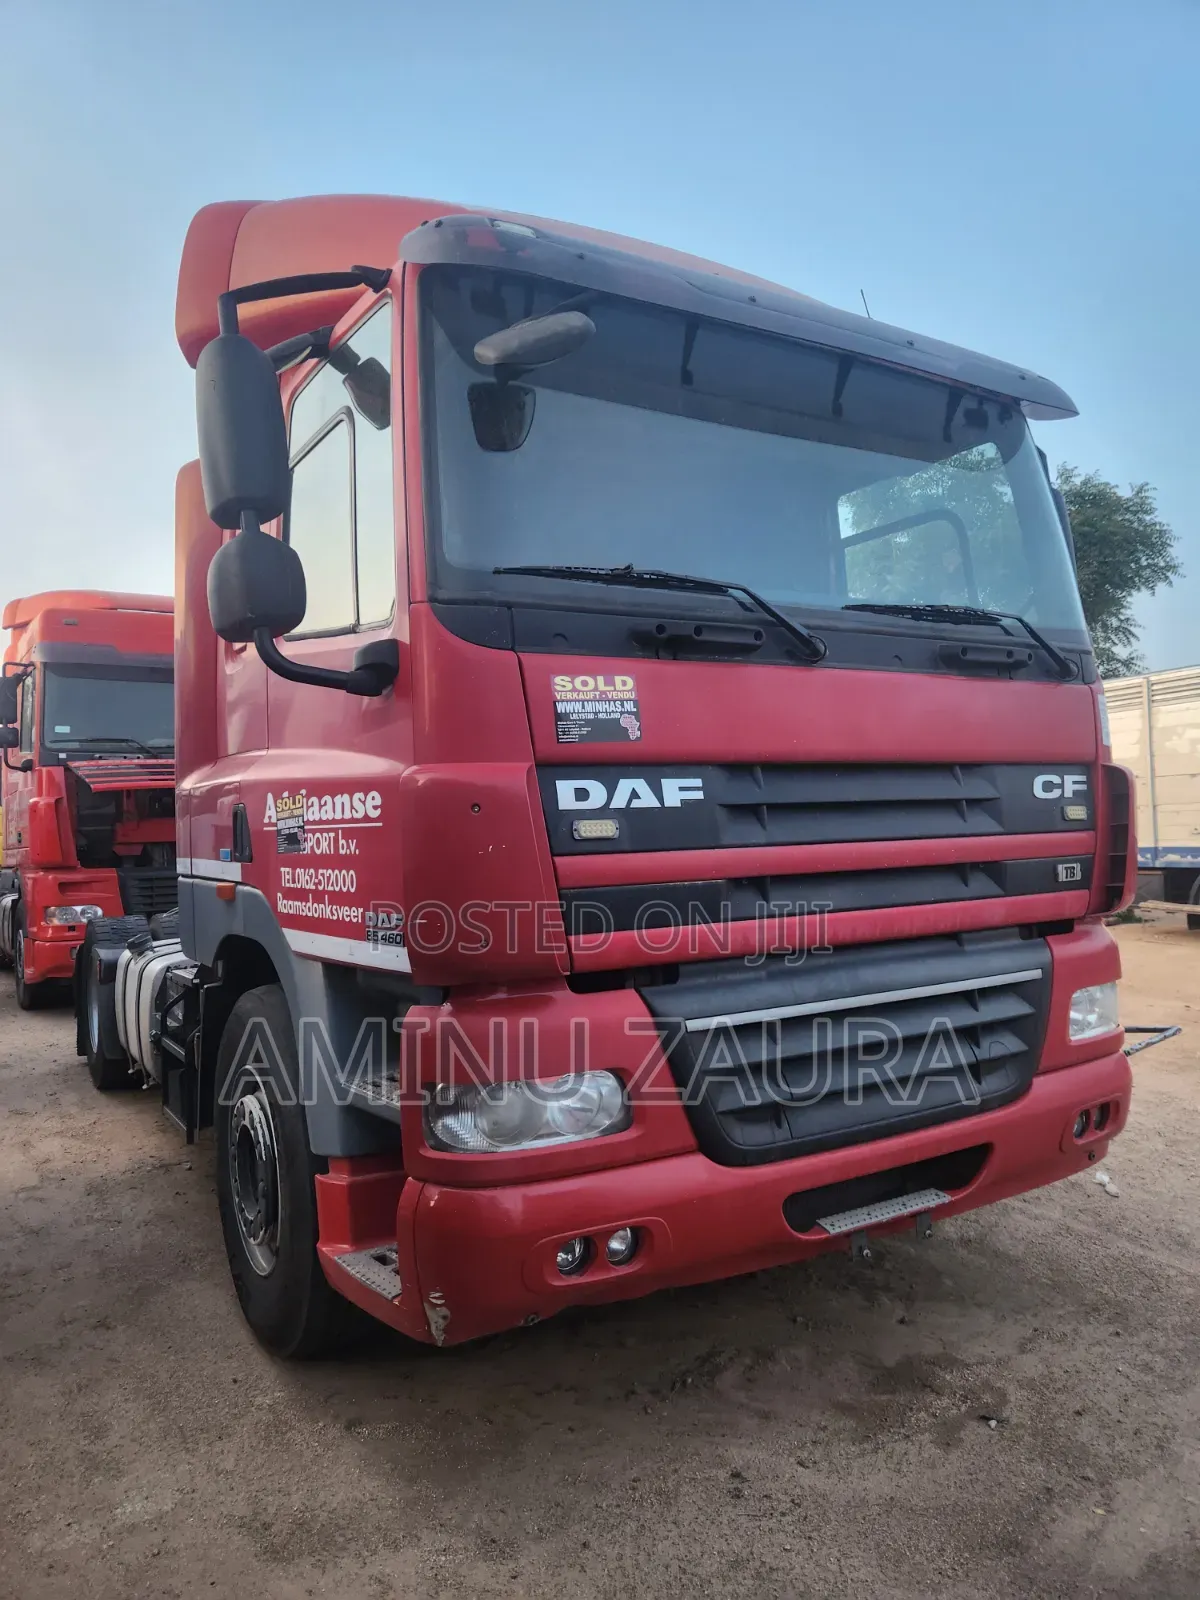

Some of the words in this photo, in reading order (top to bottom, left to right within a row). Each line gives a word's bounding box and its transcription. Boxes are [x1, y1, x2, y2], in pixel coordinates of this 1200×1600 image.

[553, 675, 634, 691] SOLD
[555, 691, 600, 700] VERKAUFT
[607, 691, 635, 699] VENDU
[556, 701, 637, 713] WWW.MINHAS.NL
[555, 778, 705, 810] DAF
[1033, 774, 1088, 799] CF
[276, 794, 304, 812] SOLD
[339, 829, 359, 855] b.v.
[277, 893, 363, 923] Raamsdonksveer
[365, 912, 403, 928] DAF
